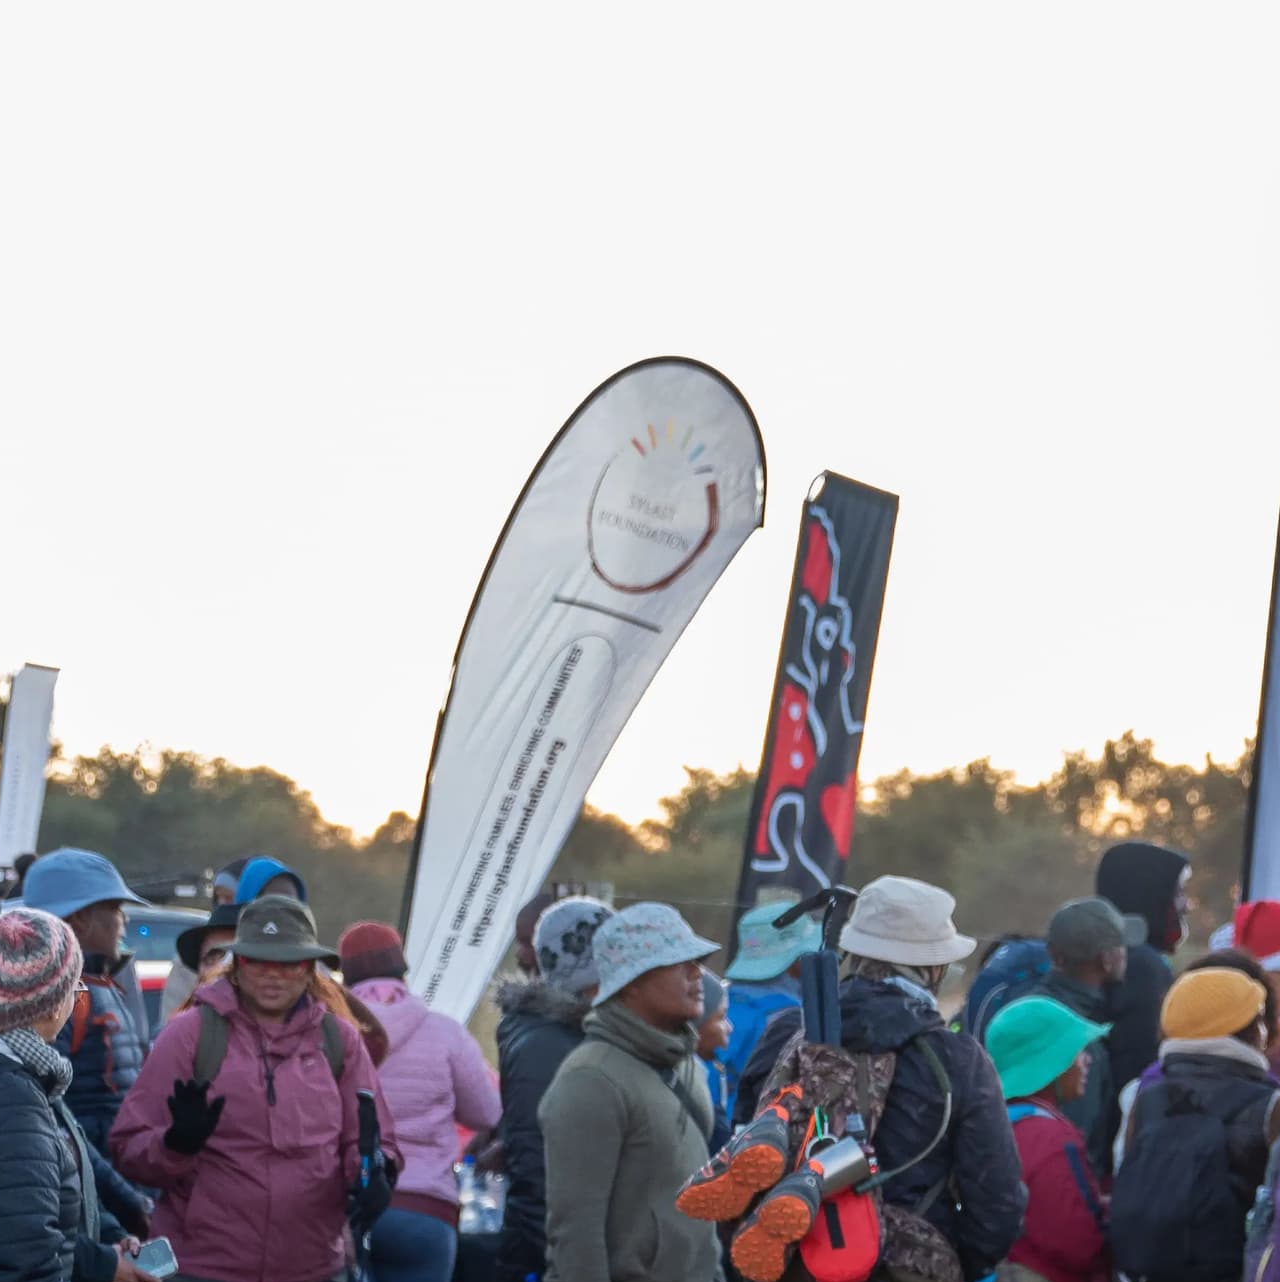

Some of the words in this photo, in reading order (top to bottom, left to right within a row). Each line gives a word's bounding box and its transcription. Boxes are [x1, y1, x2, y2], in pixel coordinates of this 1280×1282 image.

[599, 511, 689, 551] FOUNDATION
[452, 850, 493, 931] EMPOWERING
[510, 726, 544, 791] ENRICHING
[539, 645, 585, 728] COMMUNITIES
